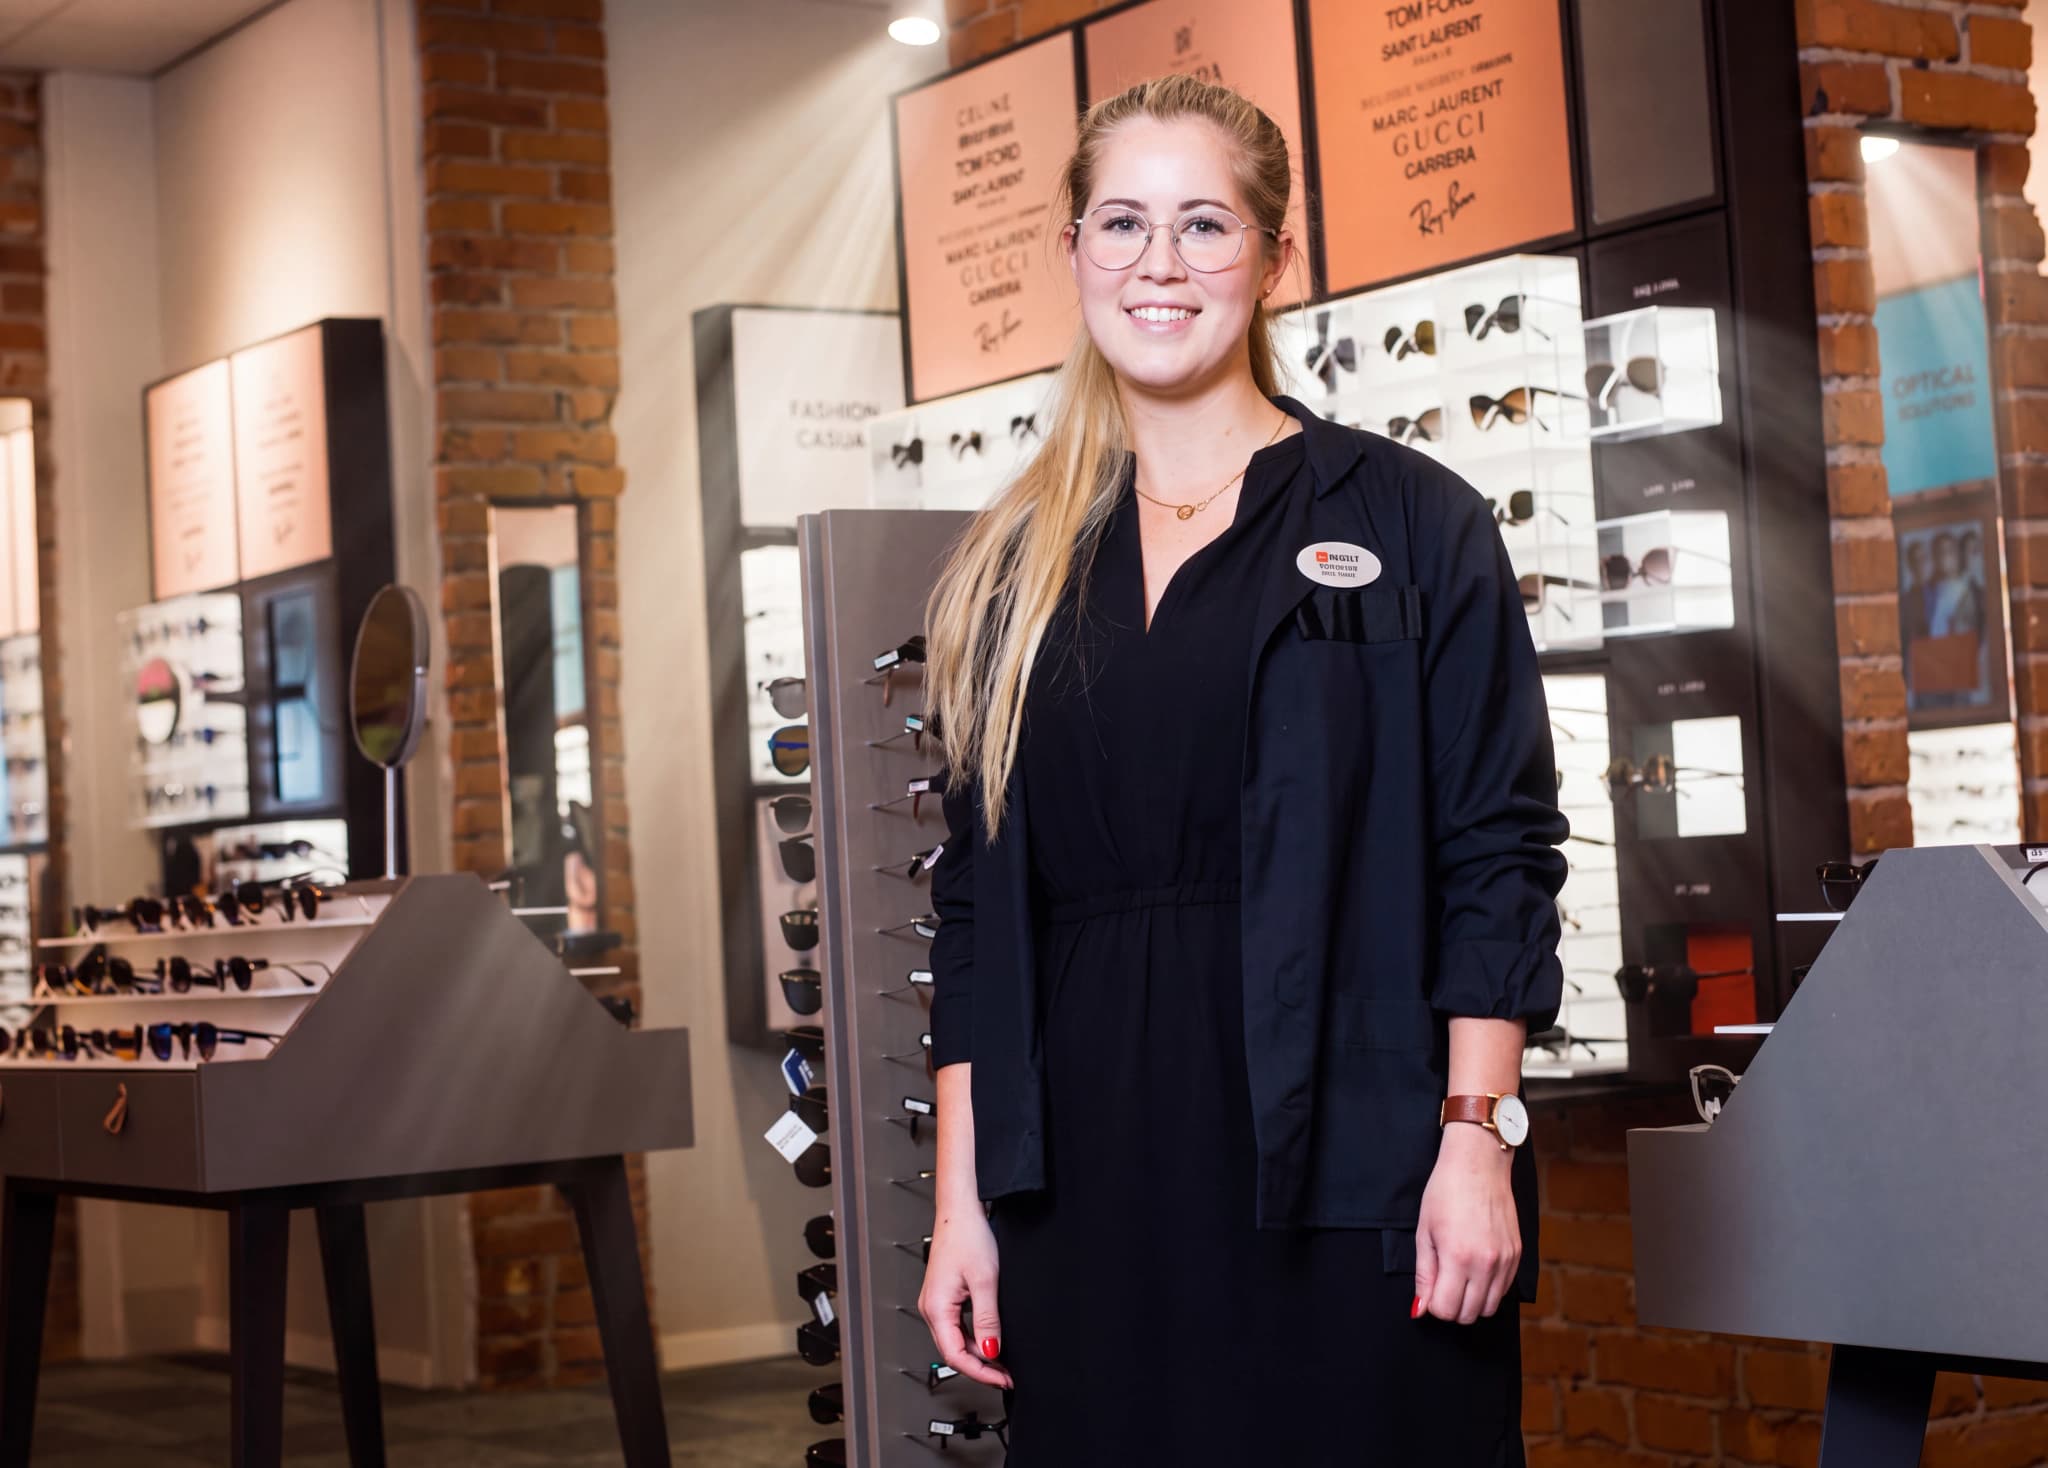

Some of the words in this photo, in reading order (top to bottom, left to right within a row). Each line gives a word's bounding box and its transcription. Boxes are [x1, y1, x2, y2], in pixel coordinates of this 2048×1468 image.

[1385, 1, 1422, 29] TOM
[1426, 0, 1474, 16] FO
[1382, 35, 1416, 62] SAINT
[1420, 14, 1483, 48] LAURENT
[1372, 105, 1418, 132] MARC
[1393, 110, 1485, 157] GUCCI
[1404, 146, 1477, 180] CARRERA
[959, 250, 1030, 288] GUCCI
[795, 427, 867, 450] CASUA
